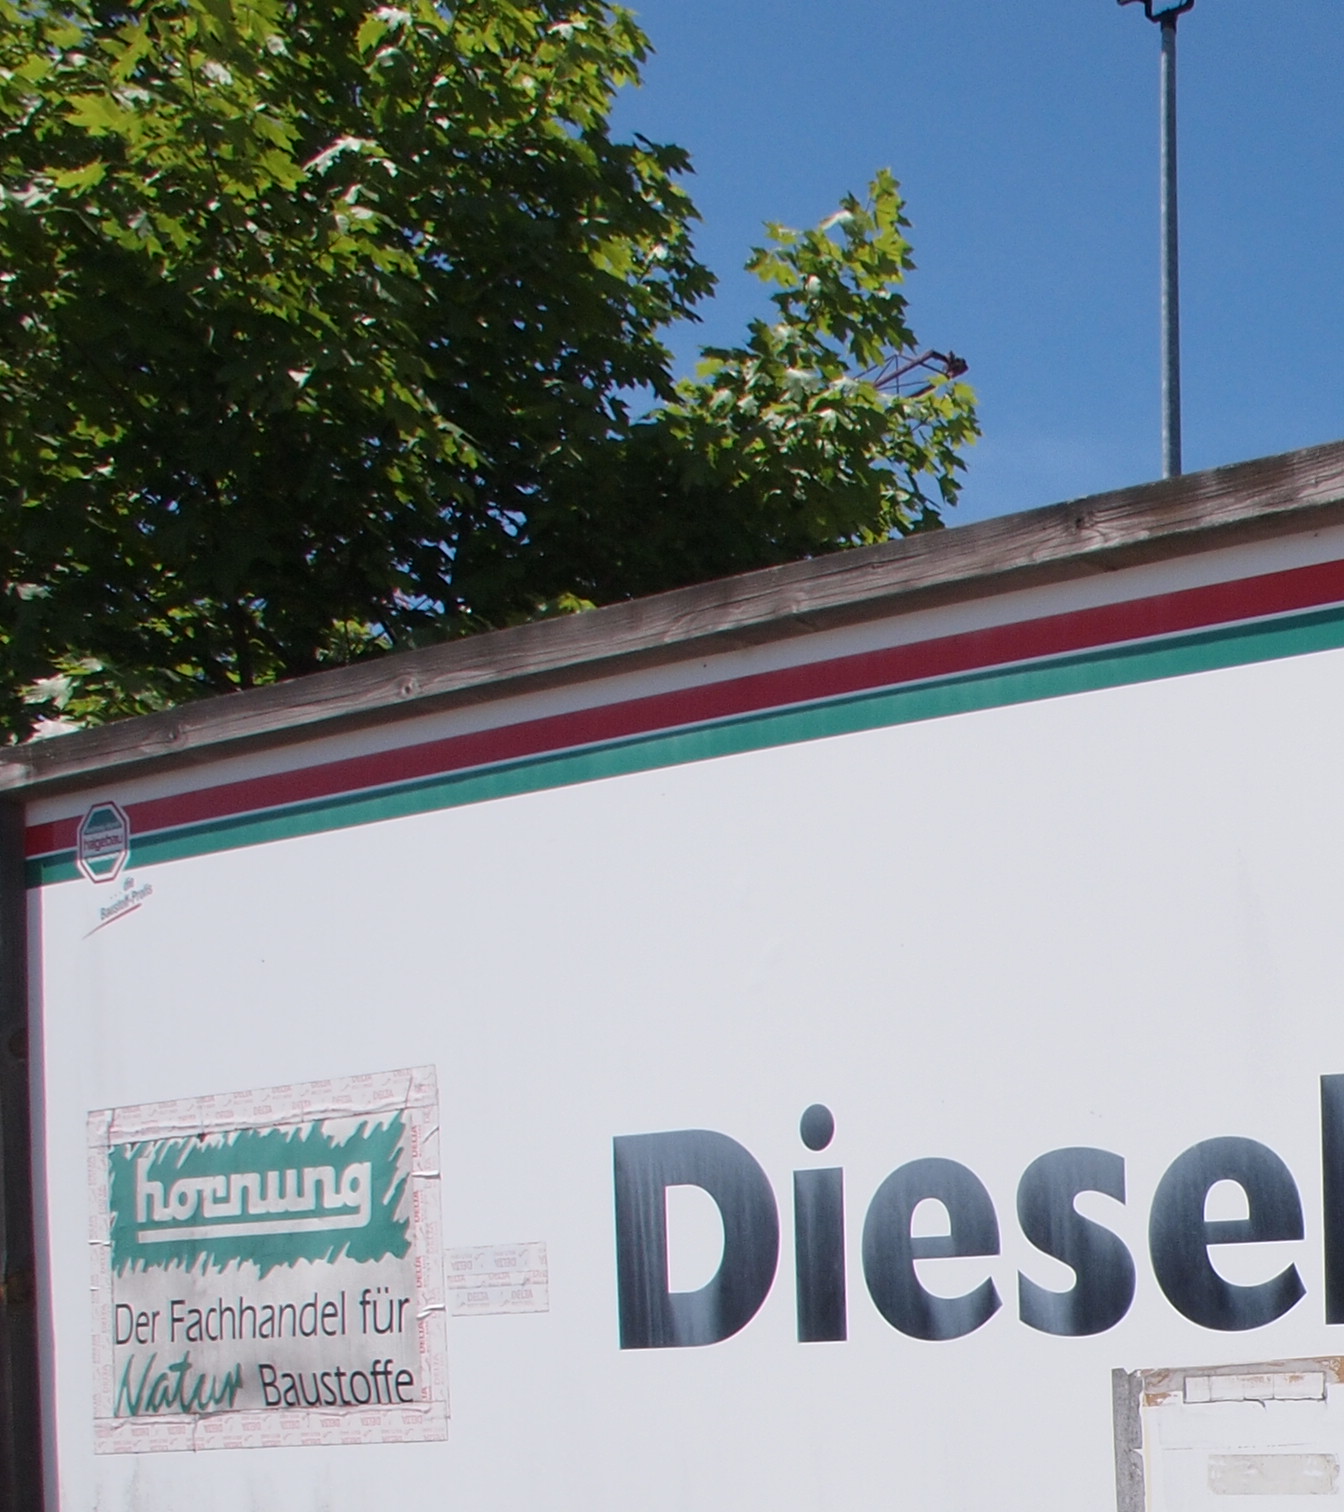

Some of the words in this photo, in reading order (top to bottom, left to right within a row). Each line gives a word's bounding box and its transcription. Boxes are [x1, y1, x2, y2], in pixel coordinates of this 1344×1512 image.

[136, 1157, 372, 1241] hornung
[115, 1303, 160, 1345] Der
[170, 1290, 345, 1342] Fachhandel
[359, 1286, 410, 1335] für
[113, 1350, 243, 1417] Natur
[258, 1359, 414, 1406] Baustoffe
